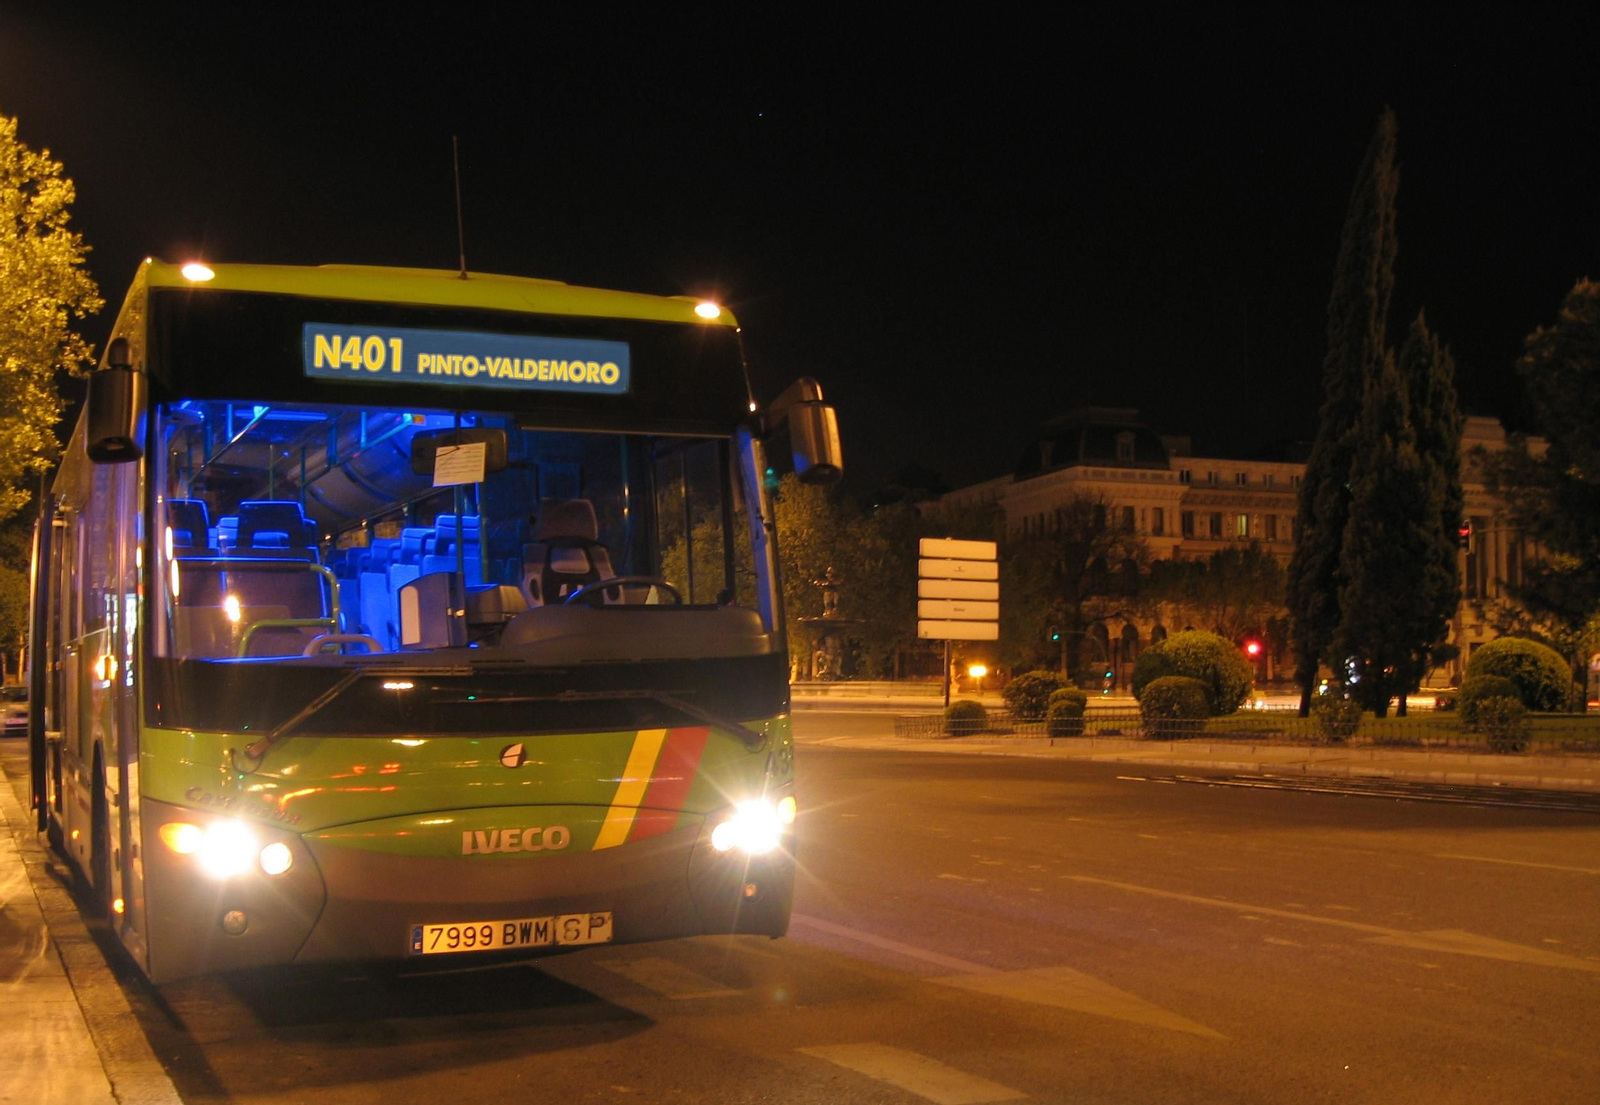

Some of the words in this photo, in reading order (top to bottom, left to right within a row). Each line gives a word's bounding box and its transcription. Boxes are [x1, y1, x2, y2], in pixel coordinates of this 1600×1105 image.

[313, 334, 403, 373] N401
[417, 353, 620, 385] PINTO-VALDEMORO
[462, 825, 570, 855] IVECO
[430, 925, 492, 950] 7999
[502, 921, 548, 946] BWM
